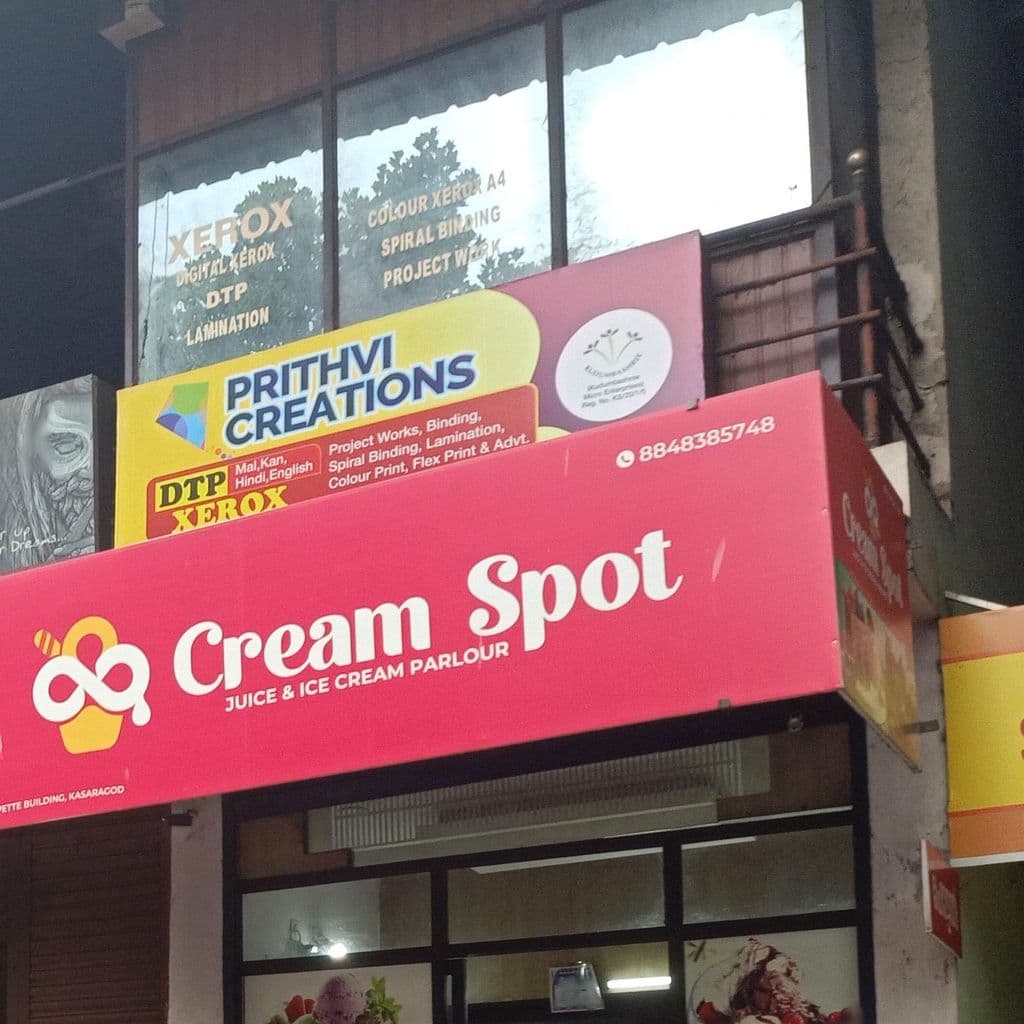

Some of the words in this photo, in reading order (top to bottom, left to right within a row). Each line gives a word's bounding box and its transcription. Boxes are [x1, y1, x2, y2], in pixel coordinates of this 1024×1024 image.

[368, 194, 428, 228] COLOUR
[432, 176, 482, 208] XEROX
[487, 170, 507, 193] A4
[168, 197, 294, 264] XEROX
[381, 224, 435, 257] SPIRAL
[438, 205, 502, 241] BINDING
[176, 255, 226, 287] DIGITAL
[229, 242, 275, 270] XEROX
[383, 252, 451, 289] PROJECT
[454, 238, 502, 268] WORK
[206, 282, 248, 309] DTP
[186, 307, 270, 346] LAMINATION
[227, 335, 393, 411] PRITHVI
[225, 353, 476, 446] CREATIONS
[328, 435, 374, 456] Project
[377, 424, 423, 445] Works,
[426, 410, 482, 432] Binding,
[328, 453, 365, 473] Spiral
[368, 442, 422, 463] Binding,
[426, 422, 505, 449] Lamination,
[639, 416, 776, 462] 8848385748
[235, 463, 314, 489] Hindi,English
[328, 471, 371, 490] Colour
[374, 462, 409, 479] Print,
[413, 454, 441, 470] Flex
[444, 444, 478, 462] Print
[480, 442, 490, 454] &
[495, 433, 531, 453] Advt.
[159, 471, 226, 508] DTP
[171, 485, 288, 534] XEROX
[14, 526, 31, 541] up
[174, 596, 432, 696] Cream
[467, 530, 684, 652] Spot
[225, 688, 278, 713] JUICE
[282, 684, 294, 700] &
[299, 678, 330, 697] ICE
[335, 662, 405, 690] CREAM
[410, 640, 511, 677] PARLOUR
[23, 792, 68, 809] BUILDING,
[69, 785, 125, 801] KASARAGOD
